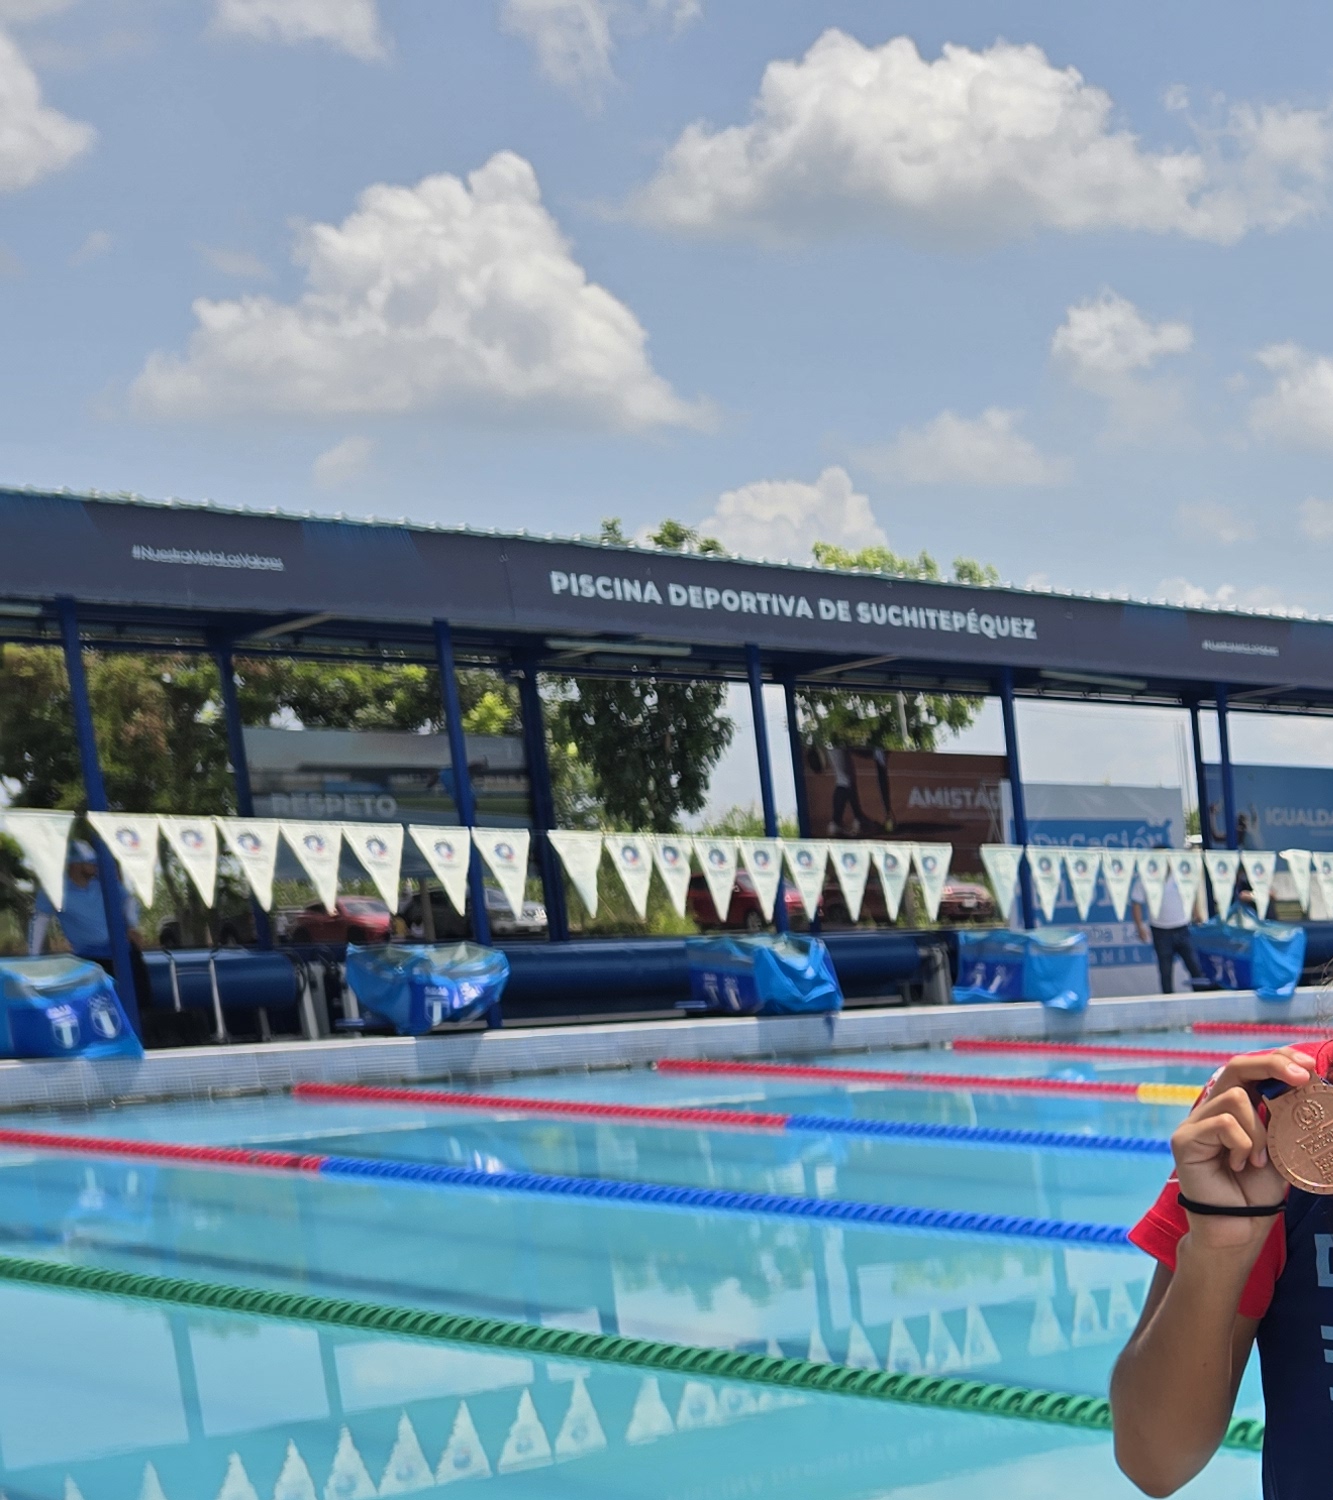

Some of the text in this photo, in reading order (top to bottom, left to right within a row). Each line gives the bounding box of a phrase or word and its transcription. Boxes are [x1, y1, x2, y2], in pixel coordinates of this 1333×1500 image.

[550, 570, 1038, 640] PISCINA DEPORTIVA DE SUCHITEPÉQUEZ
[270, 792, 397, 818] RESPETO
